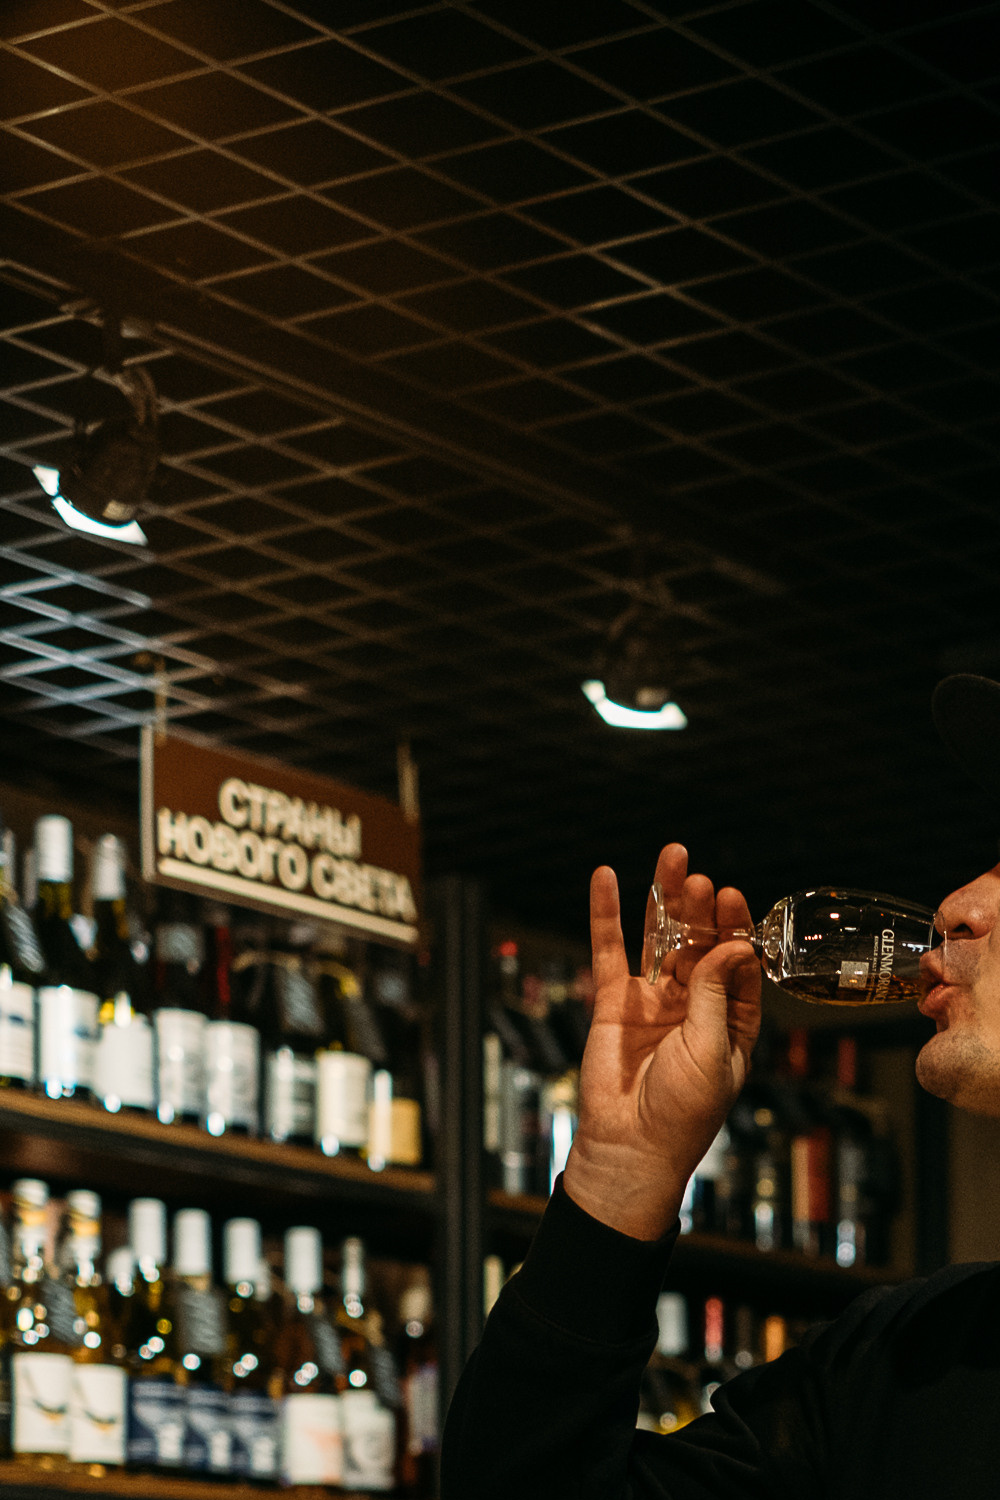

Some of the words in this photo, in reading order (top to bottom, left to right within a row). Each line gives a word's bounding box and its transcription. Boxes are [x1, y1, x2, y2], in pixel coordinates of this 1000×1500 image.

[157, 807, 309, 891] НОВОГО
[311, 852, 418, 923] СВЕТА
[218, 777, 361, 859] СТРАНЫ
